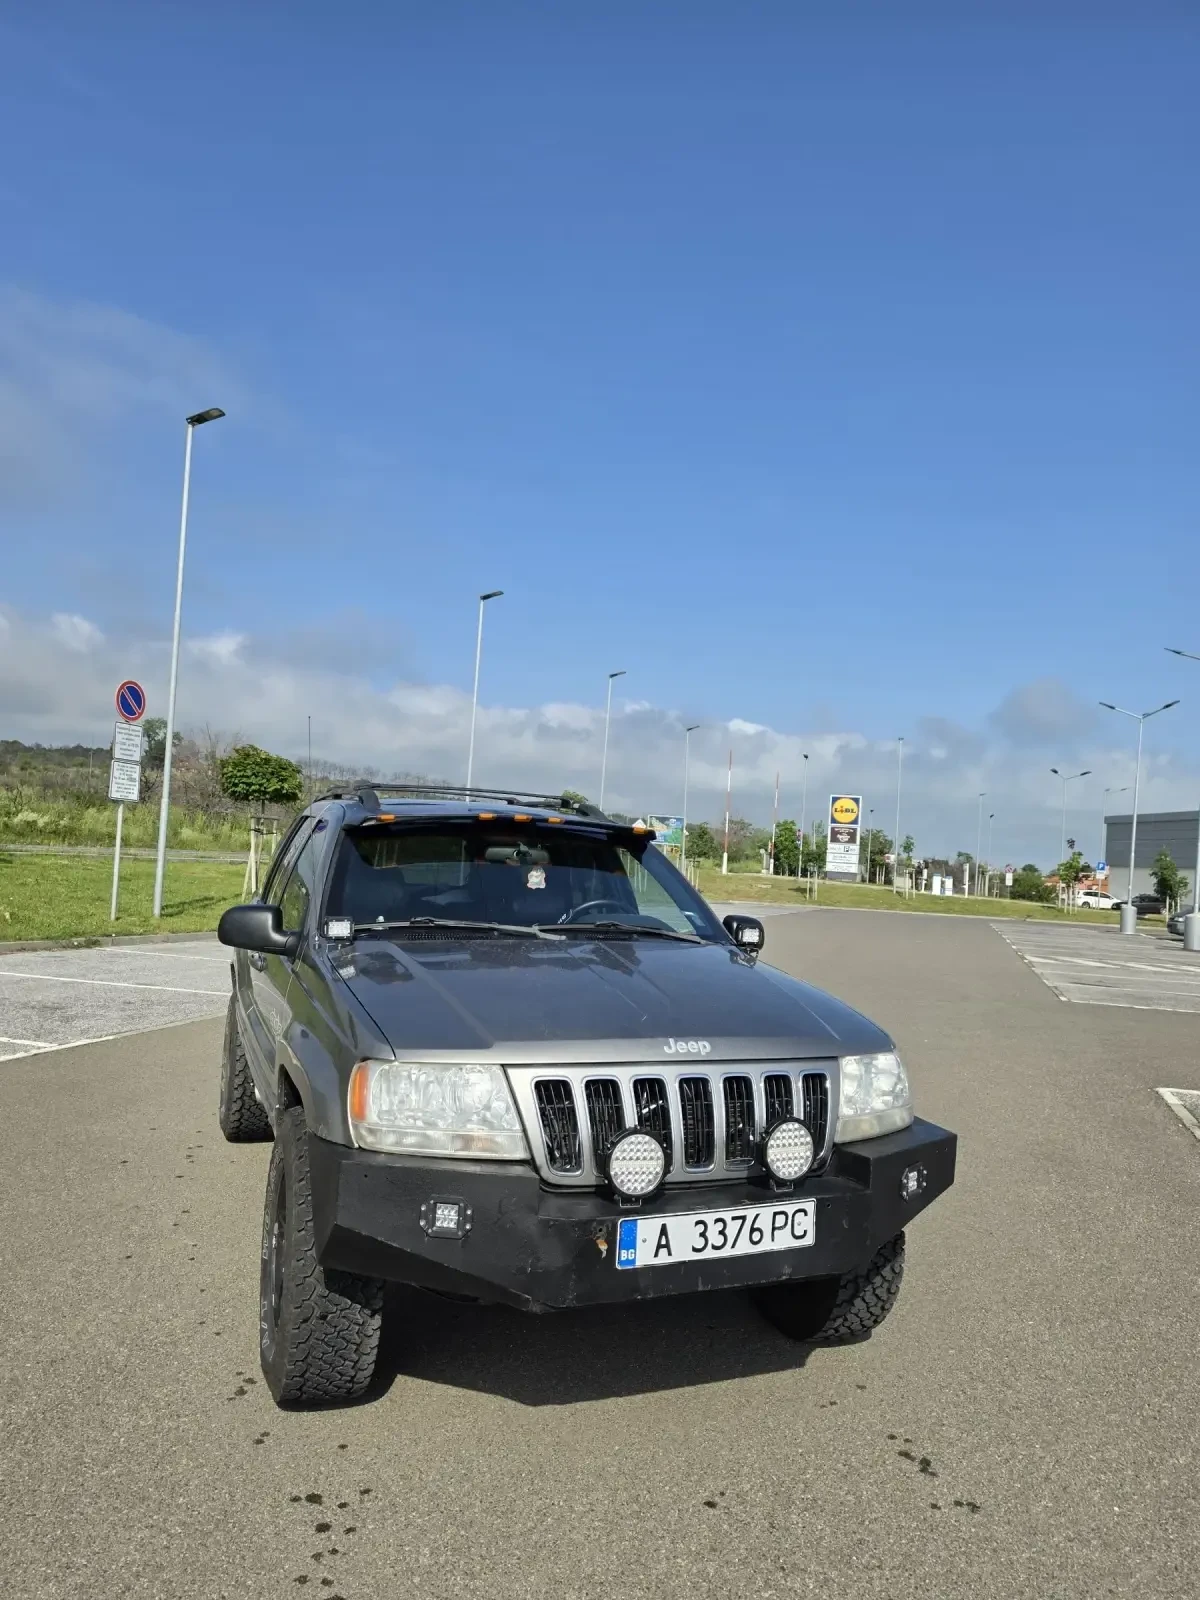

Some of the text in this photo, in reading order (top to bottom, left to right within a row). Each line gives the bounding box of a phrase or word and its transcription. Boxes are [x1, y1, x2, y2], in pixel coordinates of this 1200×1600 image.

[663, 1037, 711, 1055] Jeep
[653, 1223, 673, 1258] A
[691, 1213, 764, 1253] 3376
[620, 1249, 635, 1260] BG
